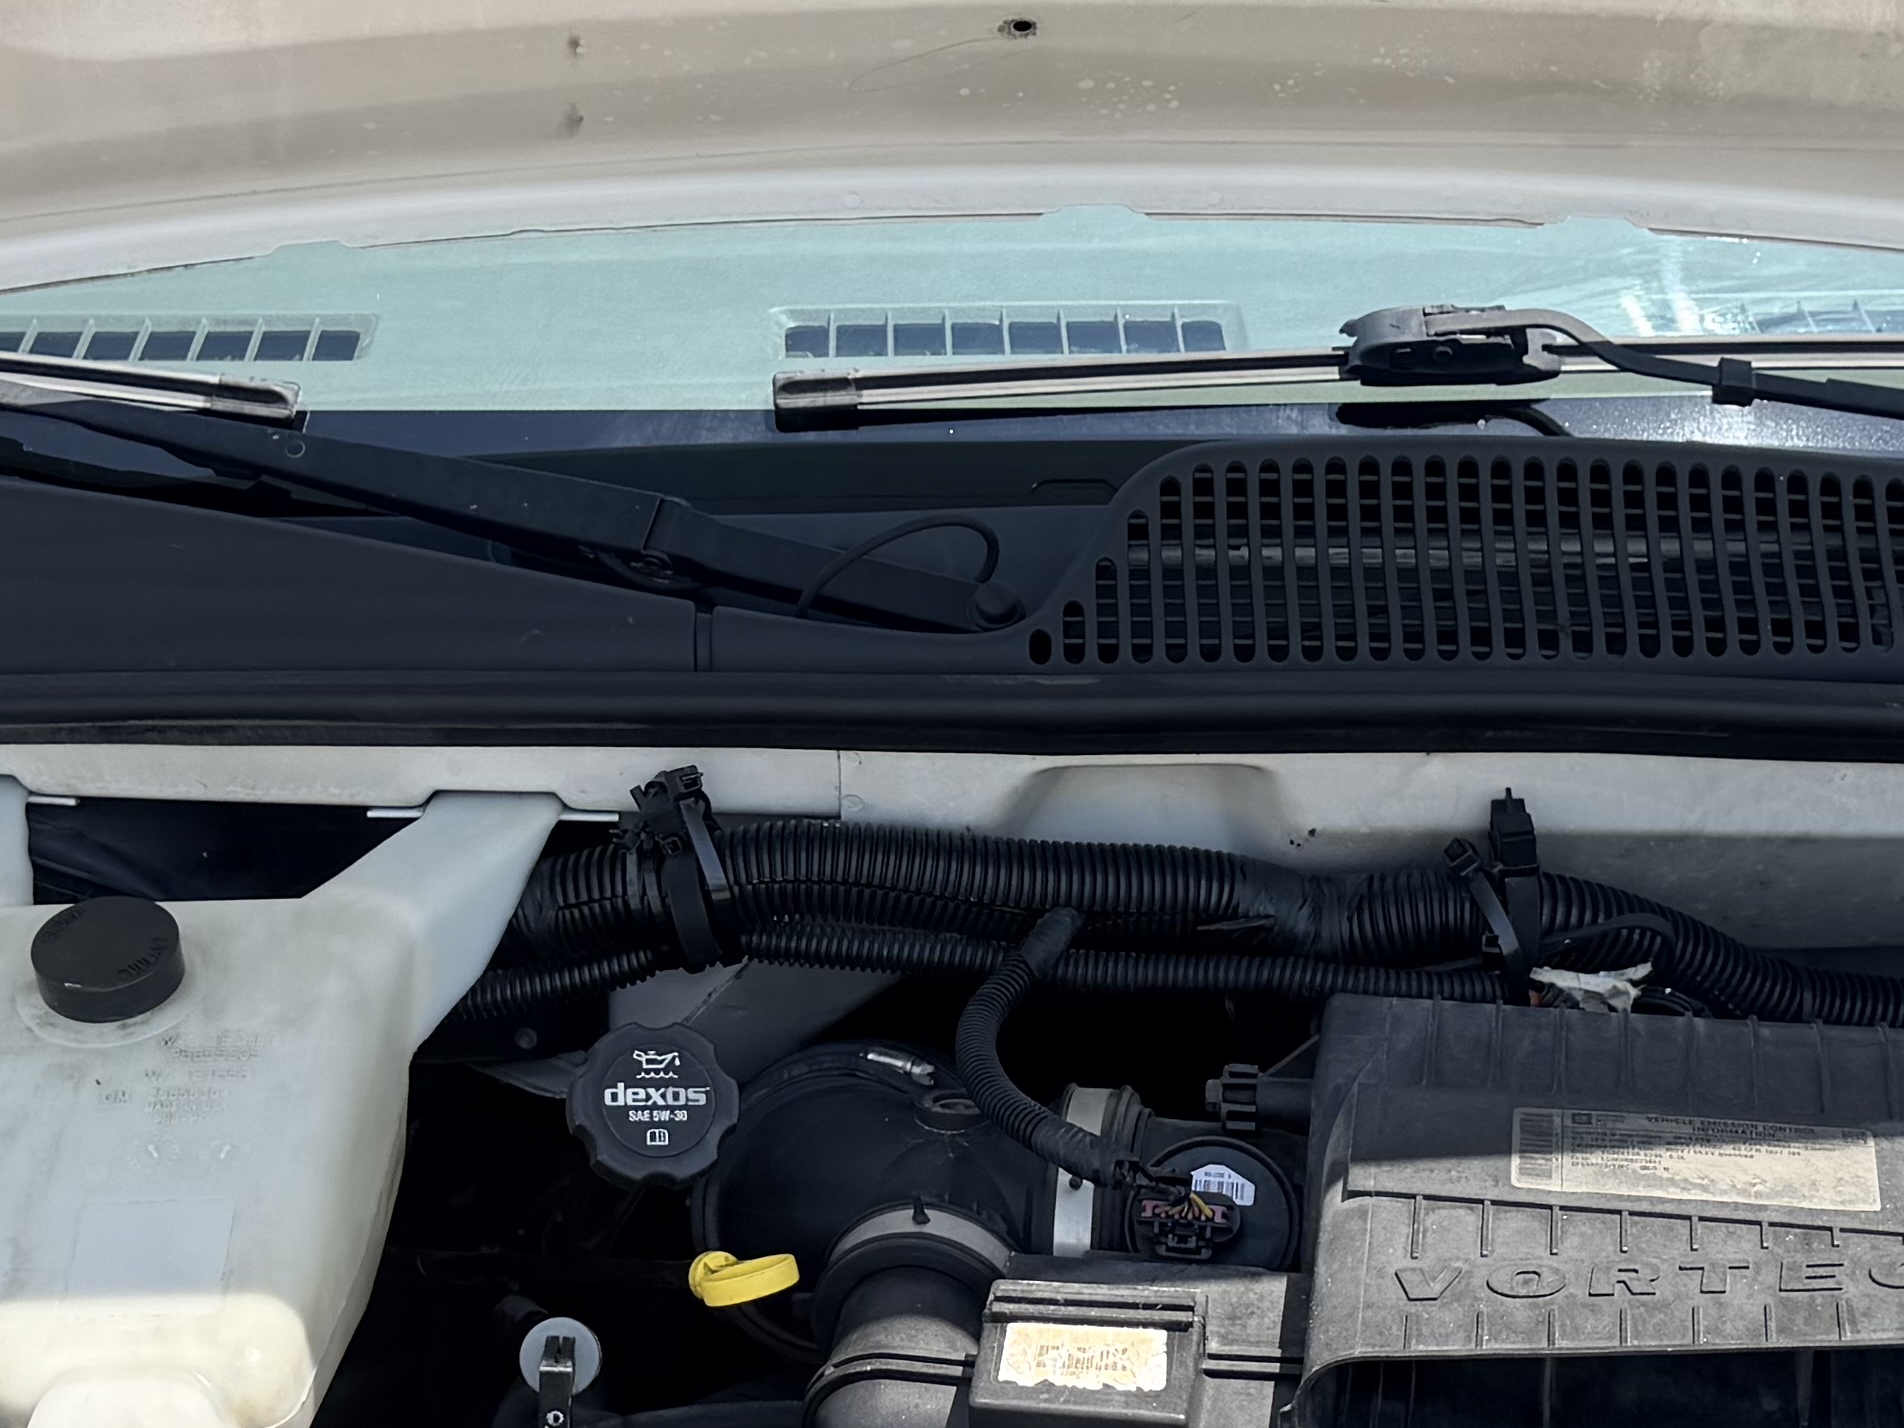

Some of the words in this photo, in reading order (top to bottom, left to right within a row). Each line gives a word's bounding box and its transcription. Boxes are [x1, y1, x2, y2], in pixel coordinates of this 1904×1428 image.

[604, 1082, 707, 1106] dexos
[629, 1110, 650, 1121] SAE
[652, 1110, 688, 1121] 5W-30
